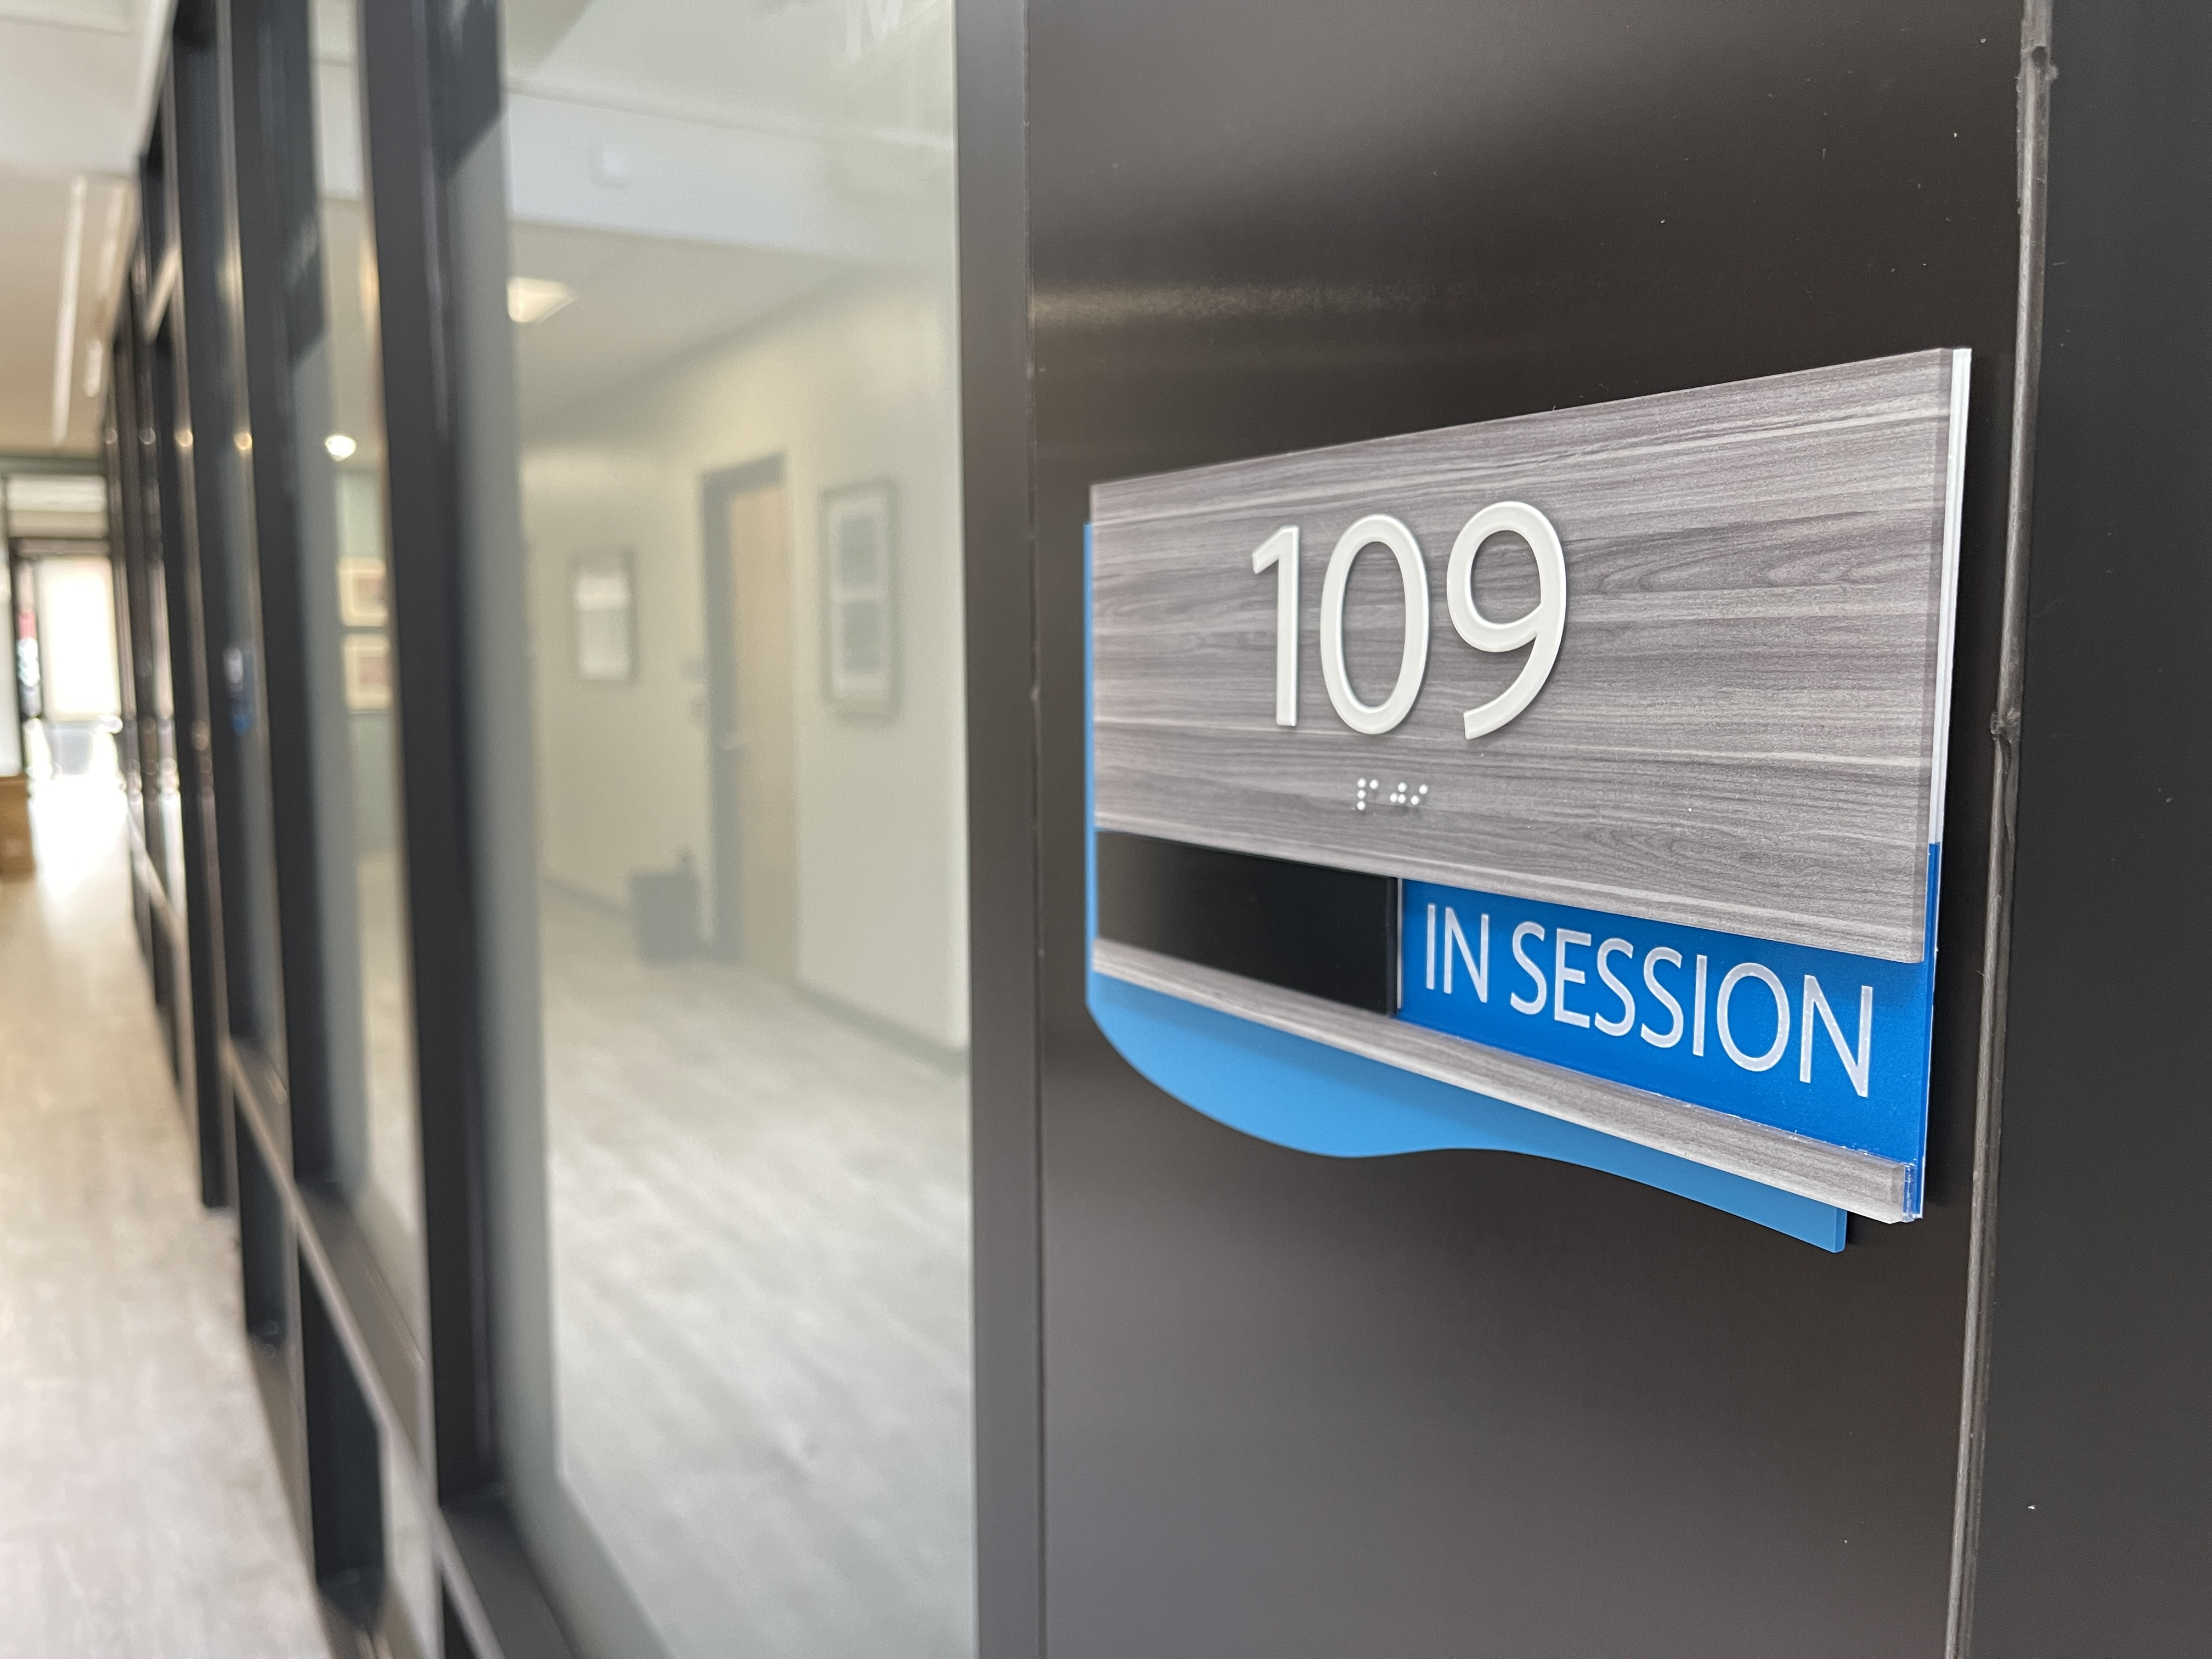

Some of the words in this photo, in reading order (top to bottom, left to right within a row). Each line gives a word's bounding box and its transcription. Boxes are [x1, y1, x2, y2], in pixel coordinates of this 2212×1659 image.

[1252, 500, 1567, 740] 109
[1426, 904, 1489, 1003] IN
[1510, 921, 1874, 1098] SESSION
